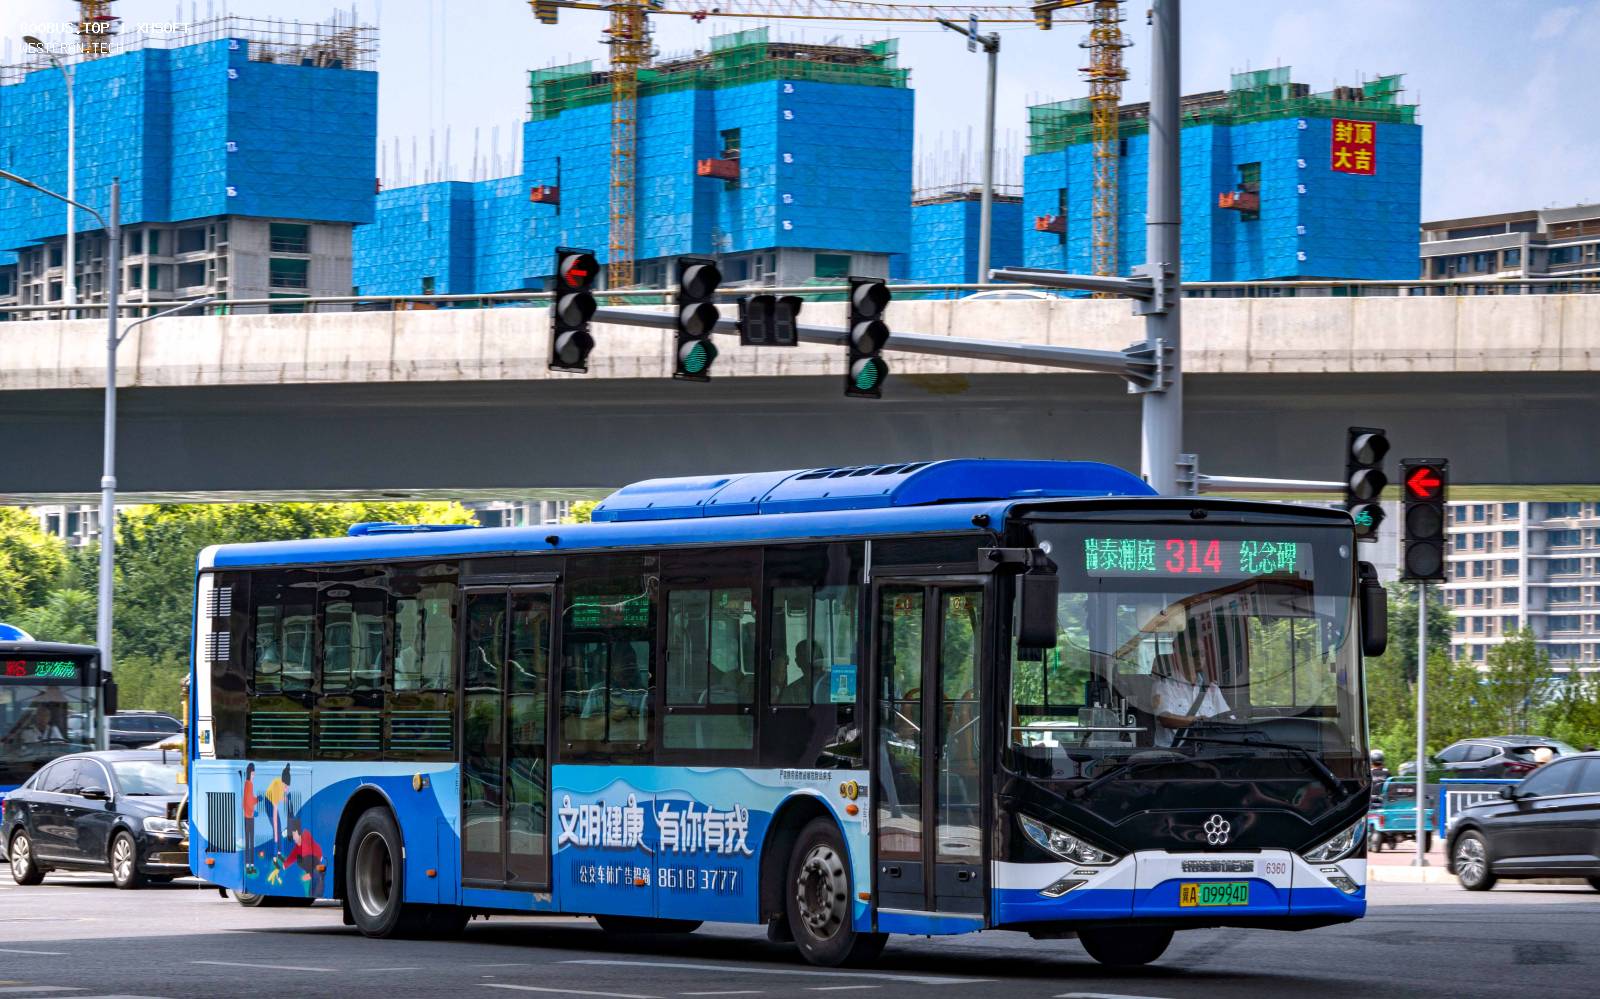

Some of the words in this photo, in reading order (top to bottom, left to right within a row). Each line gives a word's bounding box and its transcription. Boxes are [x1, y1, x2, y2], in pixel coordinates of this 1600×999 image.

[1334, 121, 1373, 144] 封顶
[1333, 146, 1373, 170] 大吉
[1164, 538, 1222, 574] 314
[1239, 540, 1297, 574] 纪念碑
[558, 793, 654, 852] 文明健康
[653, 794, 754, 855] 有你有我
[658, 868, 696, 889] 8618
[701, 869, 738, 891] 3777
[1265, 862, 1286, 875] 6360
[1202, 885, 1248, 903] 09994D
